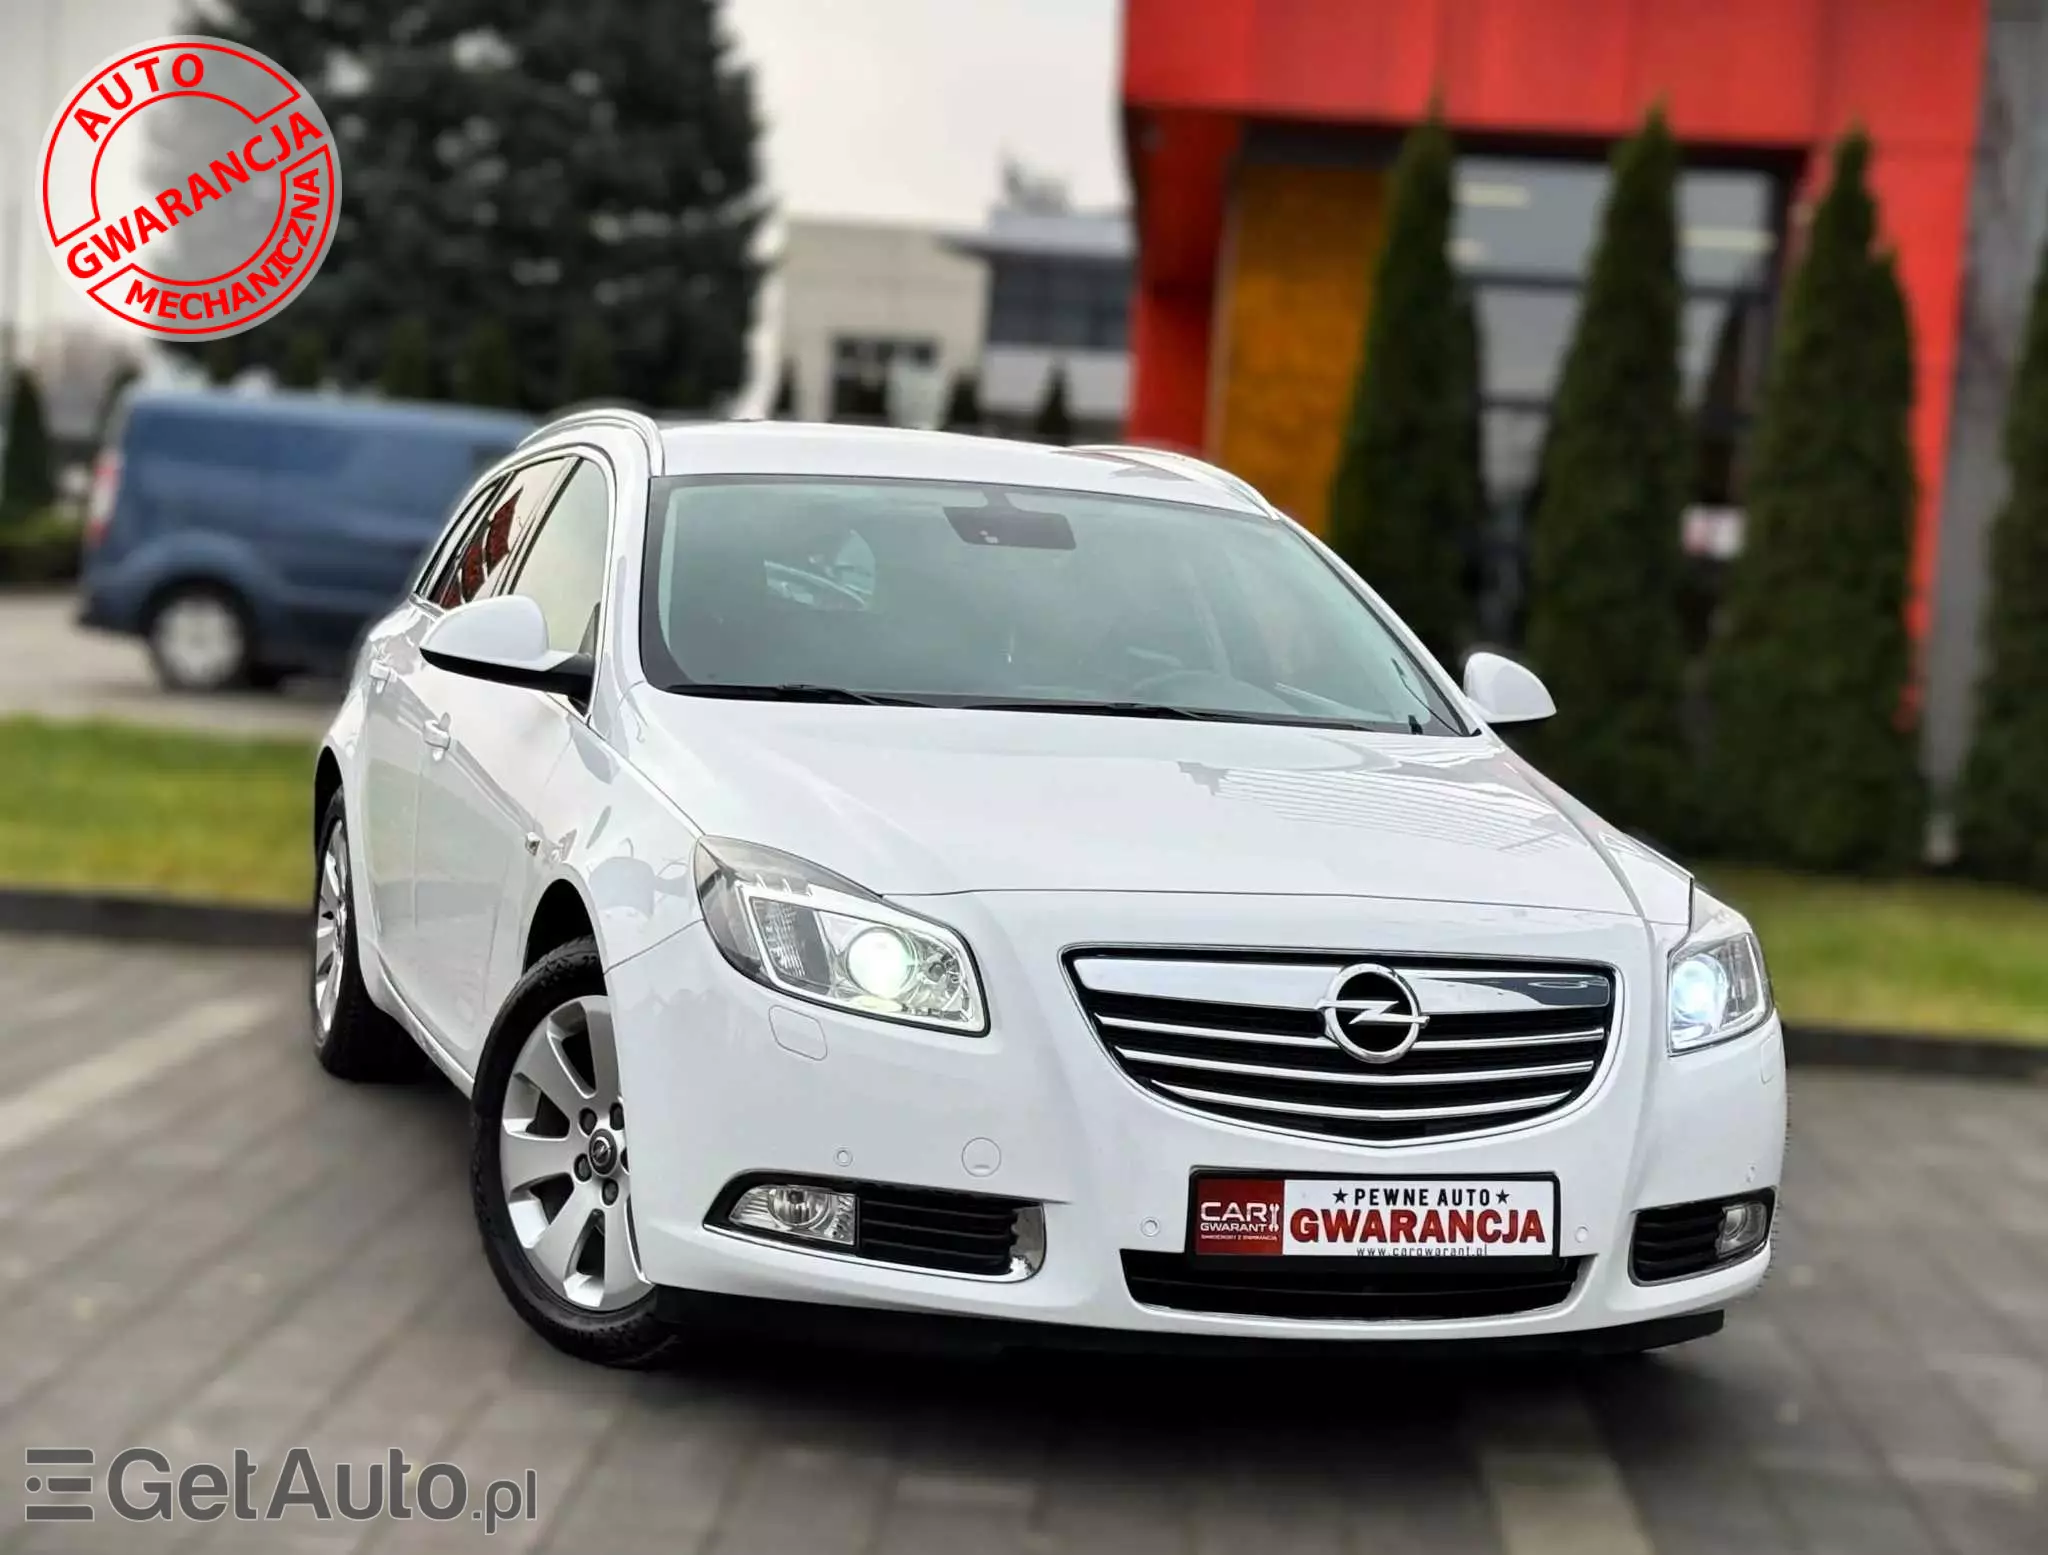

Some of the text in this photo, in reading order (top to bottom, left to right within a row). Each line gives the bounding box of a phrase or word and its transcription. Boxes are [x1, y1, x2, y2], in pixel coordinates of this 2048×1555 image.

[1354, 1188, 1490, 1206] PEWNE AUTO
[1200, 1201, 1267, 1222] CAR
[1200, 1222, 1267, 1232] GWARANT
[1290, 1208, 1546, 1243] GWARANCJA
